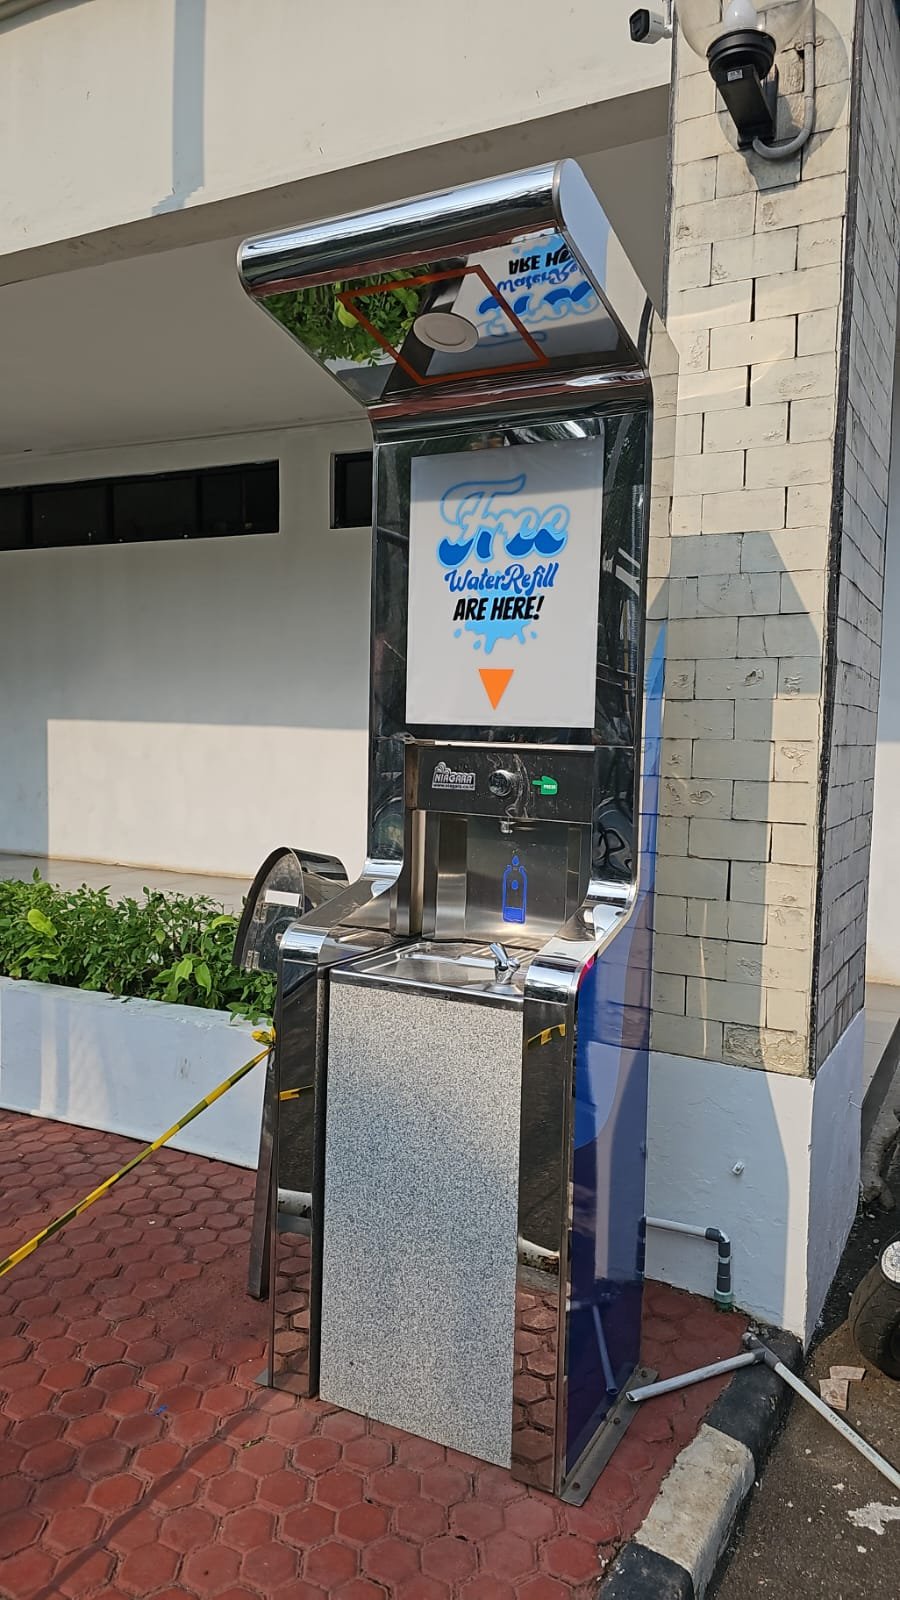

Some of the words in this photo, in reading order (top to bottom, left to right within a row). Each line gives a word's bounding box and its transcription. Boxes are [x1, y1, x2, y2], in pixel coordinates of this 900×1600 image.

[436, 473, 571, 568] Free
[453, 597, 489, 621] ARE
[490, 595, 545, 621] HERE!
[434, 772, 473, 784] NIAGARA
